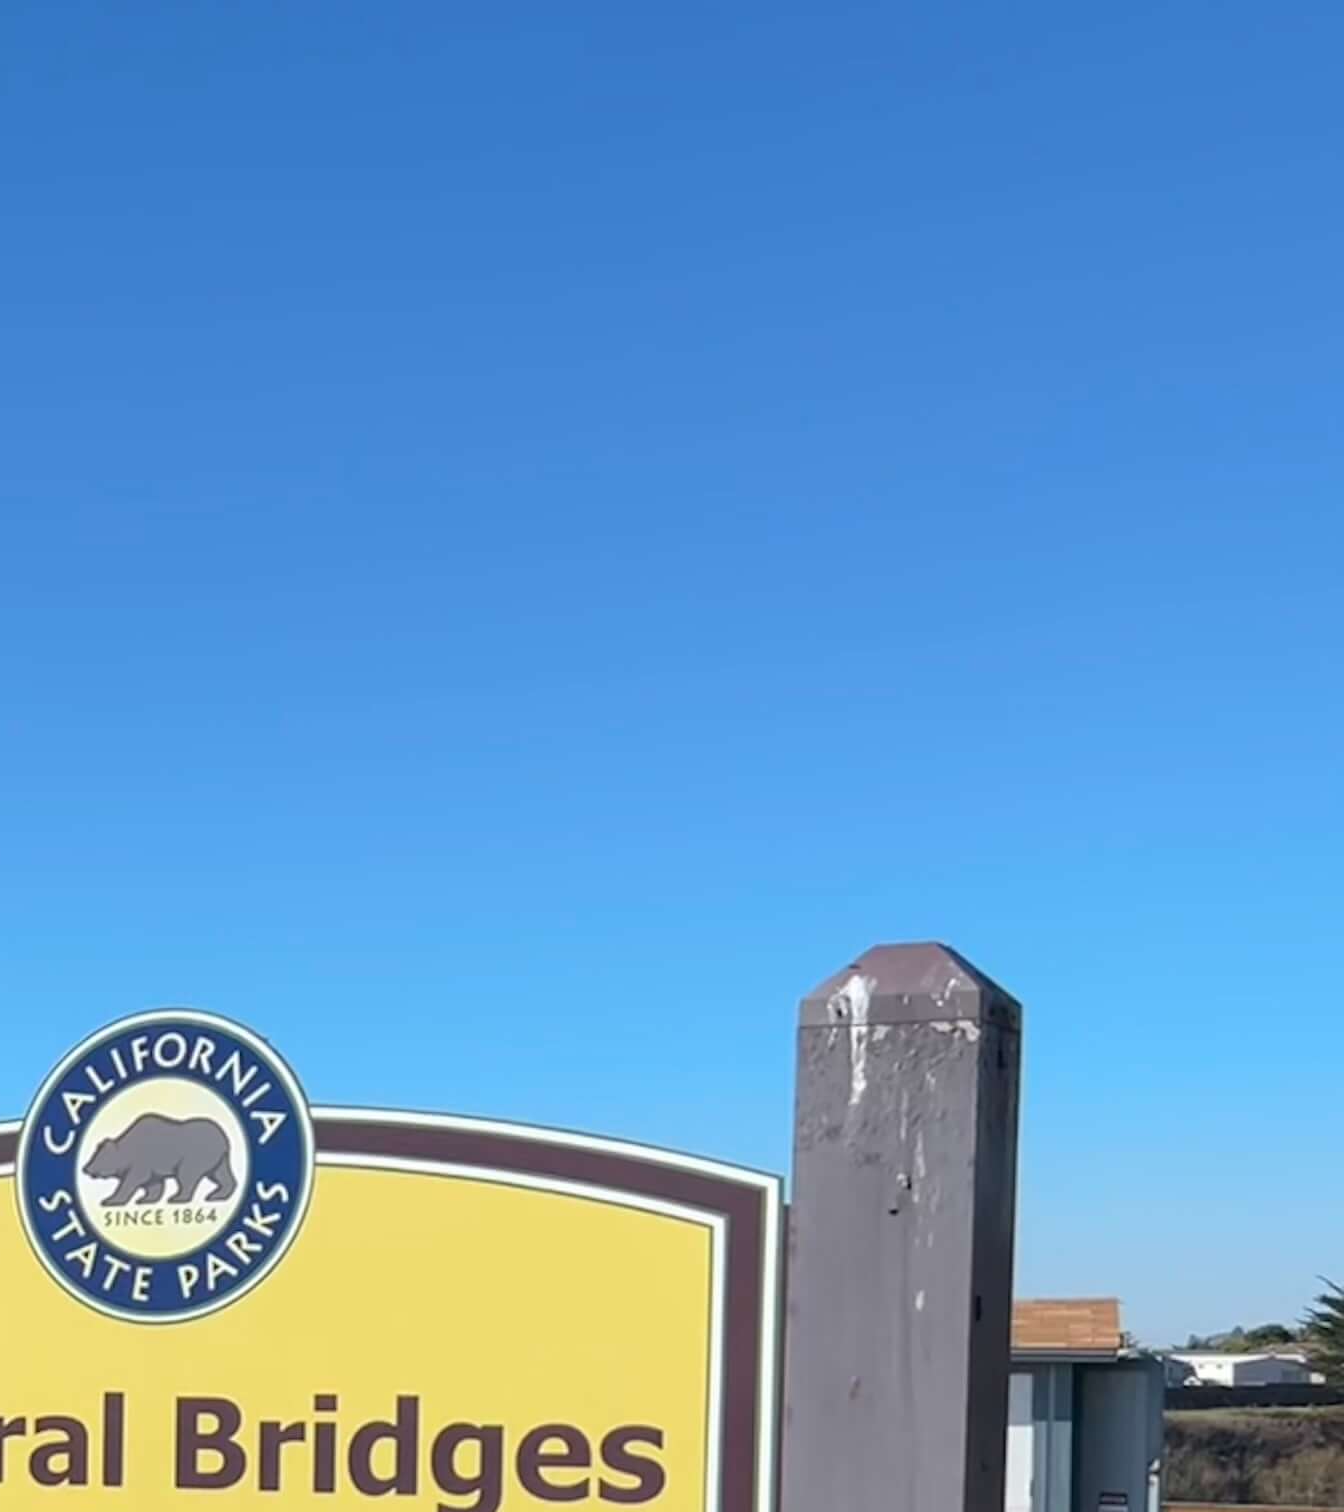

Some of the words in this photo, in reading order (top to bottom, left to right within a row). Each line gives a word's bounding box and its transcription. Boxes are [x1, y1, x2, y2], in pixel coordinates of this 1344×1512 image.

[43, 1032, 287, 1155] CALIFORNIA
[39, 1189, 153, 1302] STATE
[176, 1181, 289, 1299] PARKS
[104, 1208, 164, 1227] SINCE
[173, 1207, 217, 1224] 1864
